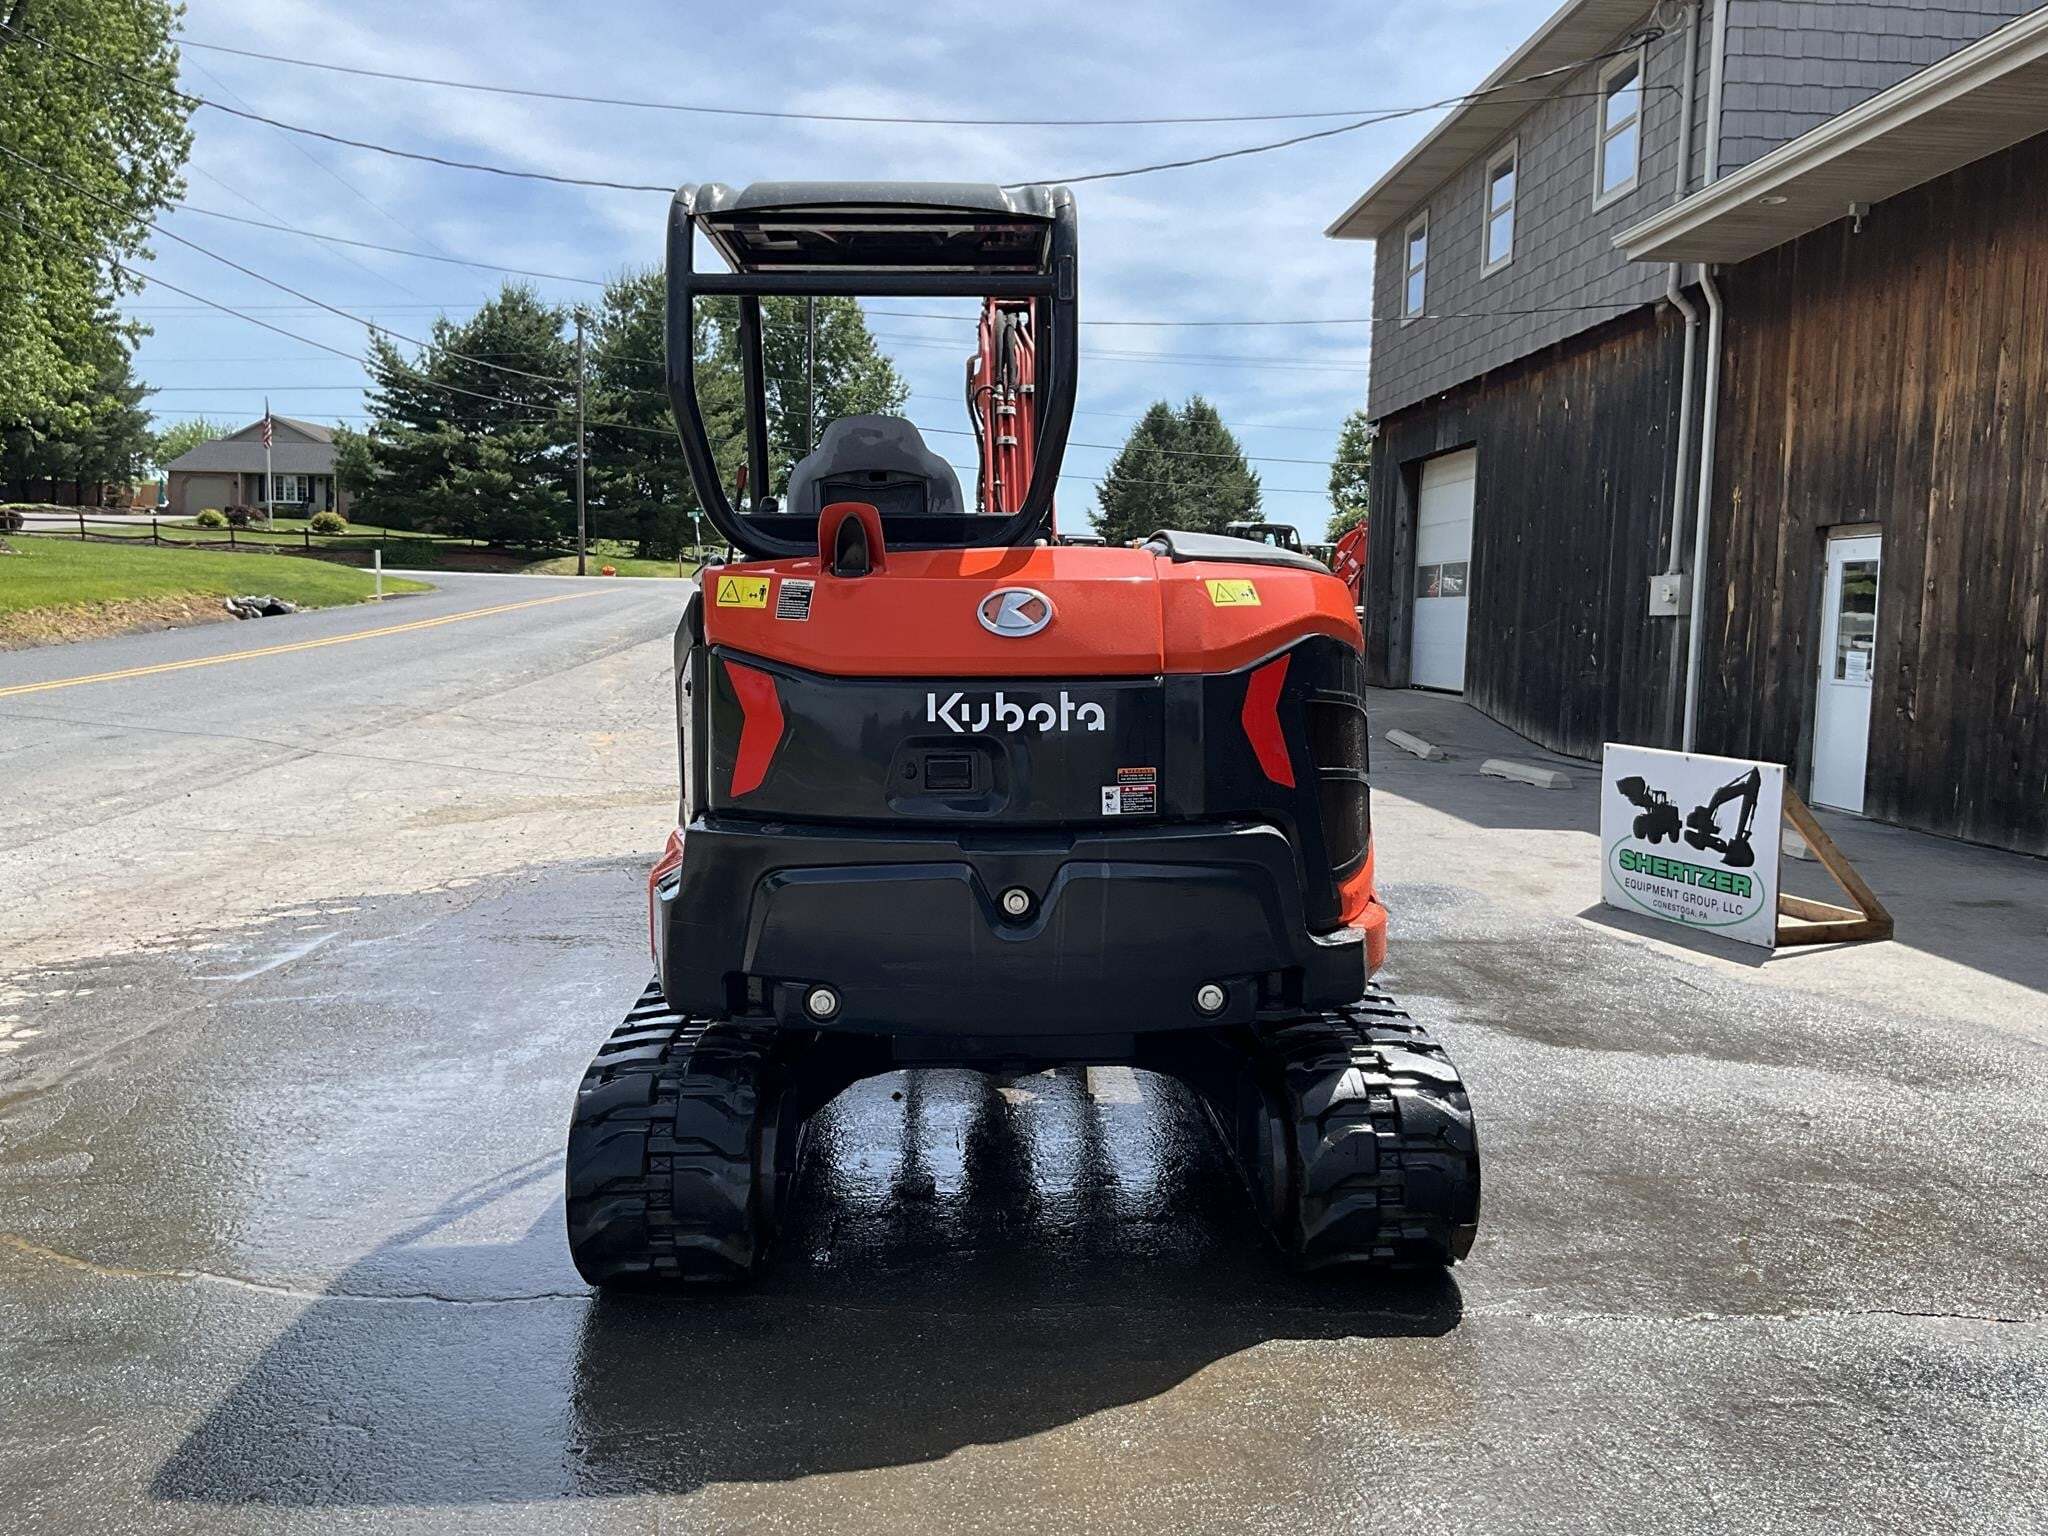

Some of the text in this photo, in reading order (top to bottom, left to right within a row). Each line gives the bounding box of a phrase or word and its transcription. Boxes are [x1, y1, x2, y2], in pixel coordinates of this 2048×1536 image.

[926, 691, 1106, 733] Kubota
[1619, 849, 1752, 898] SHERTZER
[1625, 877, 1679, 900] EQUIPMENT
[1723, 901, 1743, 915] LLC
[1700, 910, 1708, 920] PA
